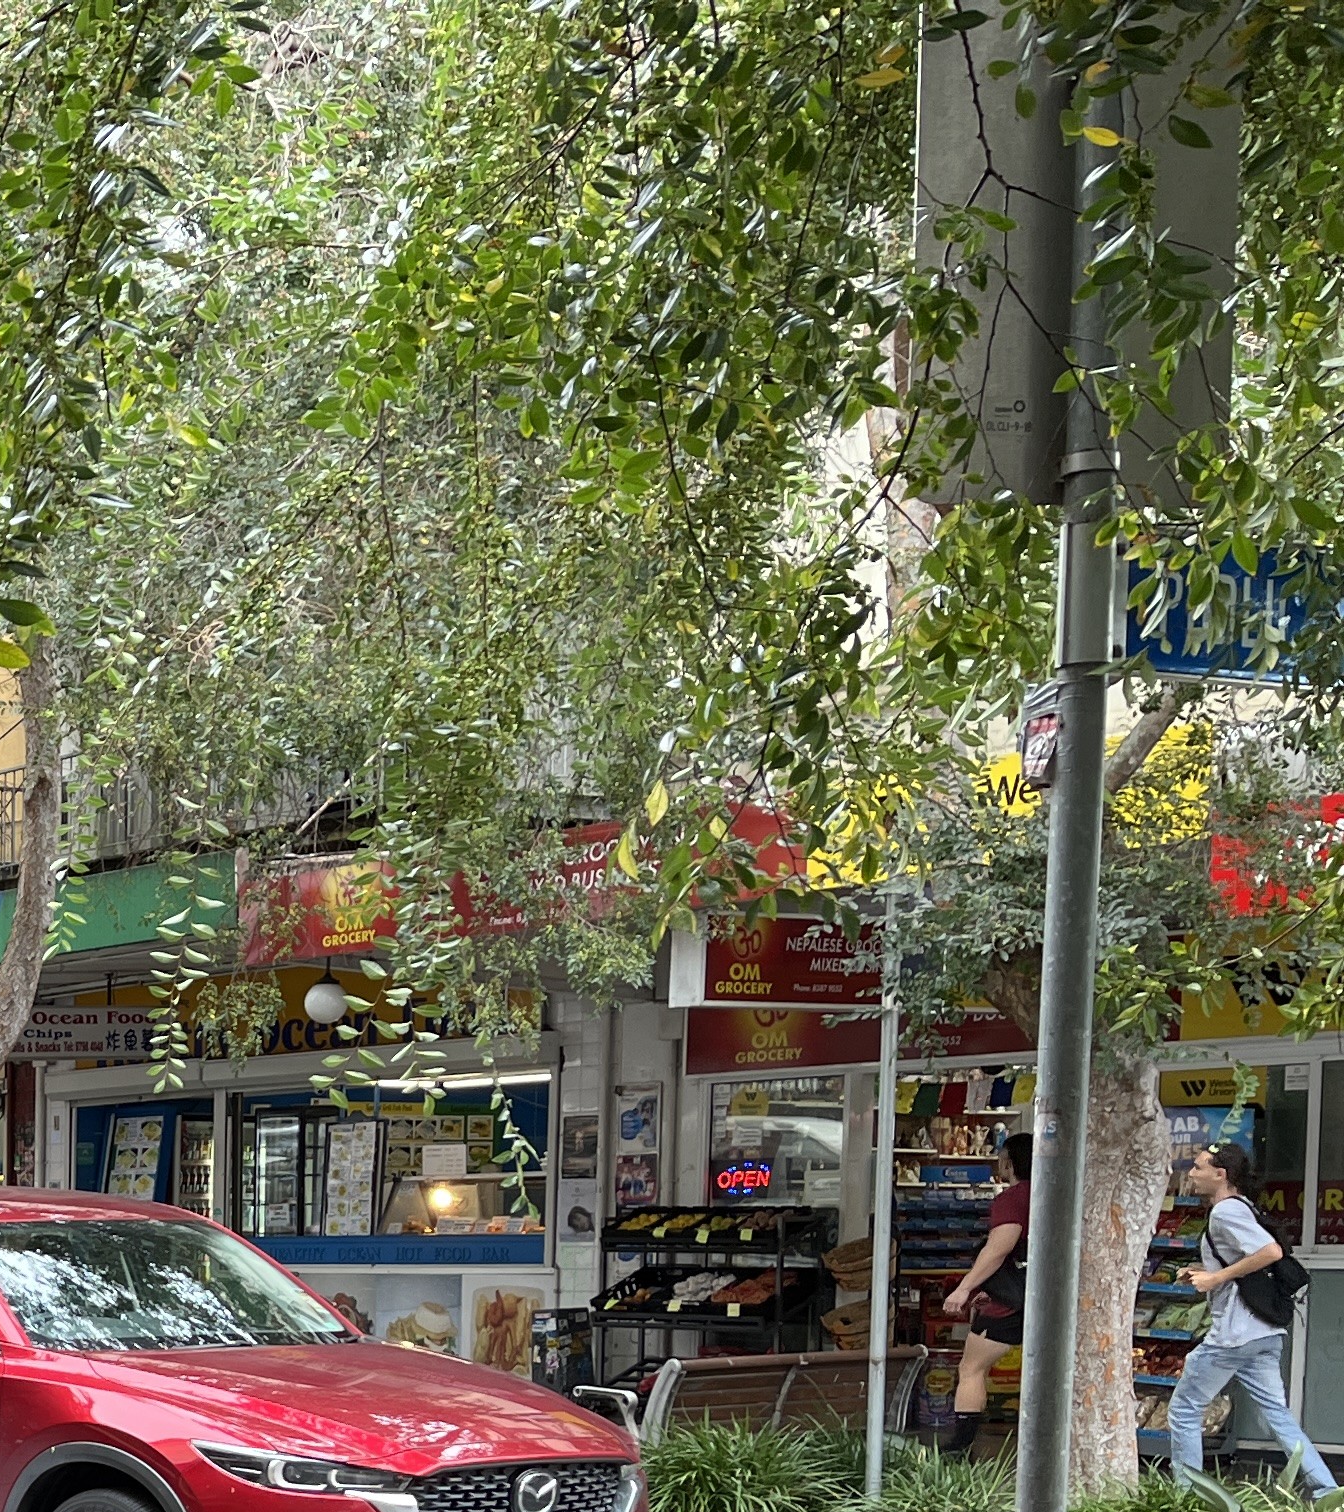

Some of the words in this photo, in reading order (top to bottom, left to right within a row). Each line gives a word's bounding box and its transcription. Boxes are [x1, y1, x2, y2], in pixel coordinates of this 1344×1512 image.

[322, 929, 378, 948] GROCERY
[786, 937, 843, 952] NEPALESE
[729, 962, 760, 980] OM
[715, 981, 772, 995] GROCERY
[32, 1011, 98, 1025] Ocean
[24, 1028, 72, 1040] Chips
[105, 1030, 170, 1051] 炸魚薯
[751, 1031, 788, 1048] OM
[735, 1048, 803, 1064] GROCERY
[717, 1170, 771, 1189] OPEN
